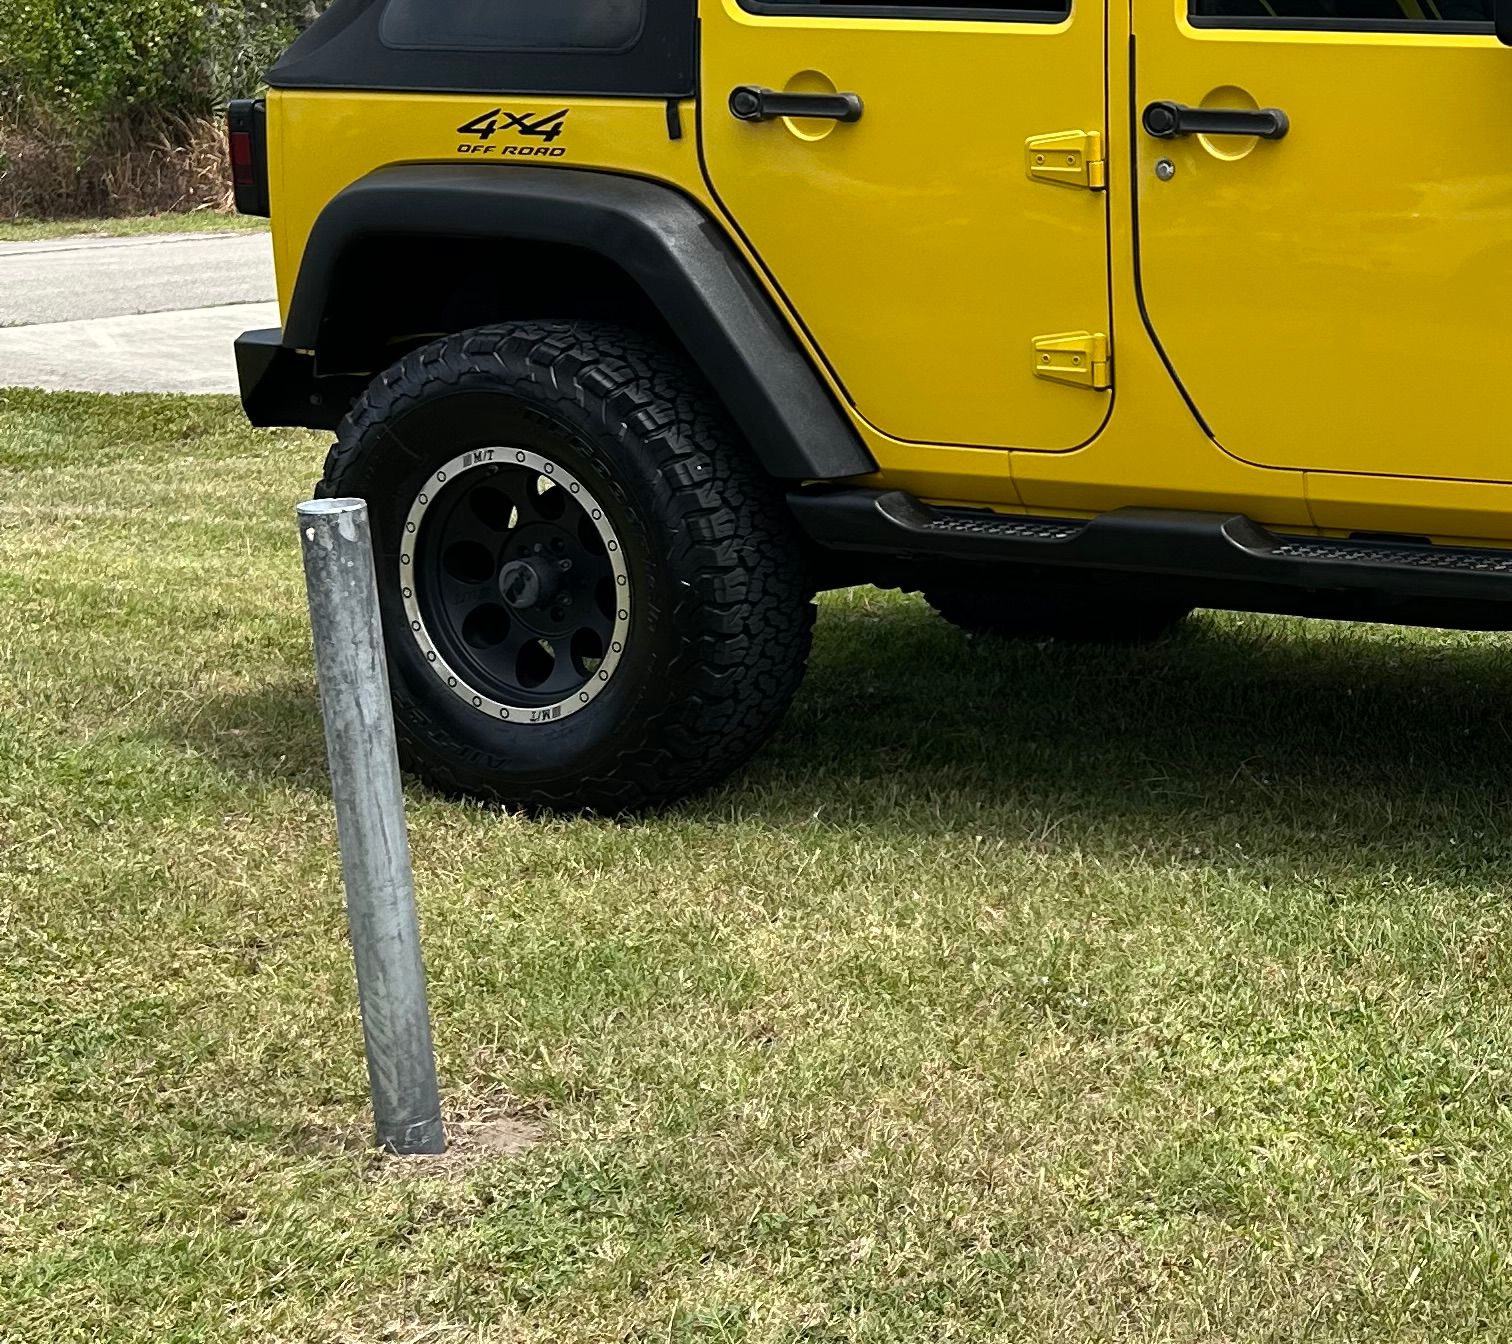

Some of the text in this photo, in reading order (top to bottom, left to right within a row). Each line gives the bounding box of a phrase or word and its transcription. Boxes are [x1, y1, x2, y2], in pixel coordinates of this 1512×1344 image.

[456, 143, 567, 157] OFF ROAD
[473, 449, 495, 463] M/T
